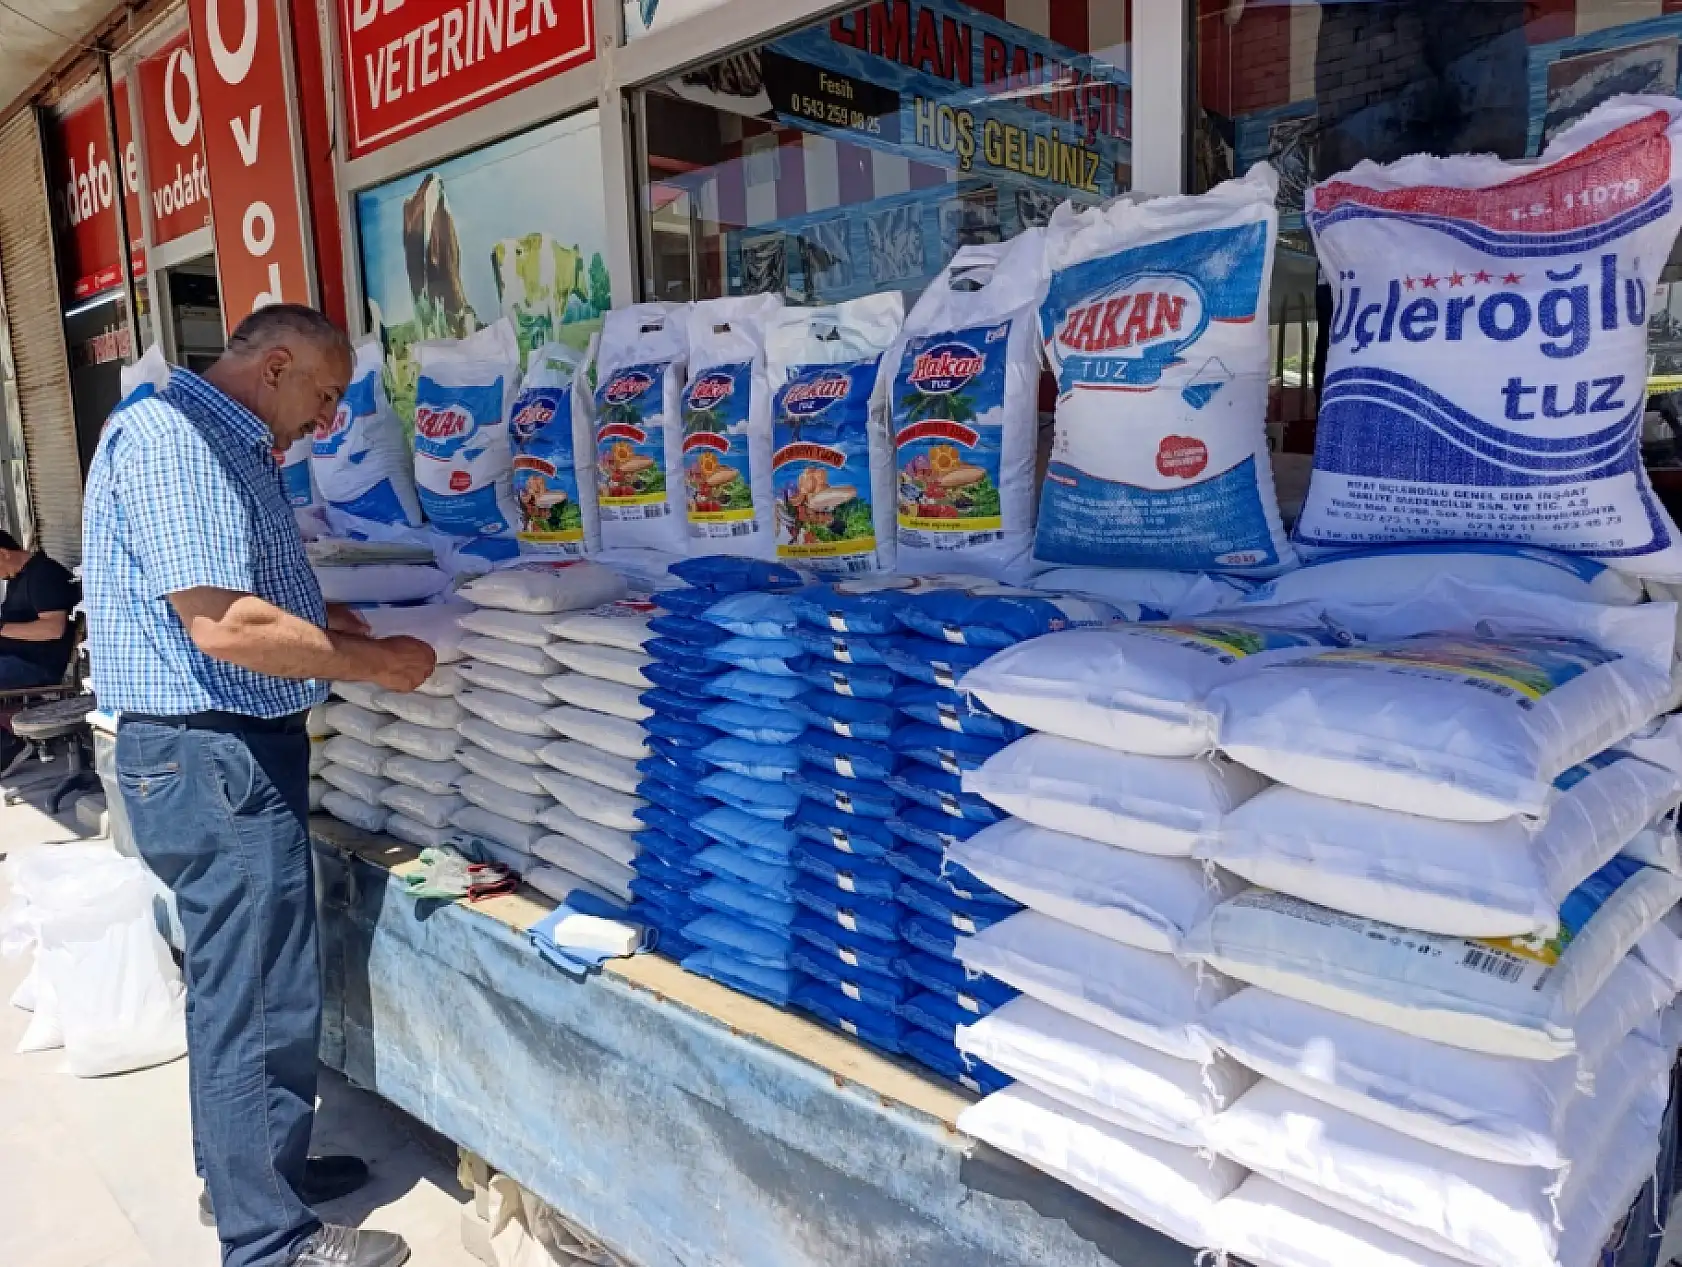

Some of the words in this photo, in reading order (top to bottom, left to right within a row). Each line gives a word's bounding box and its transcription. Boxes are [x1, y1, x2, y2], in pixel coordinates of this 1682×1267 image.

[791, 93, 800, 112] 0
[802, 95, 824, 119] 543
[914, 97, 976, 171] HOŞ
[983, 117, 1102, 193] GELDİNİZ
[1563, 178, 1642, 210] 11079
[1058, 291, 1187, 353] HAKAN
[908, 352, 985, 382] Hakan
[1081, 360, 1129, 381] TUZ
[1501, 375, 1626, 421] tuz
